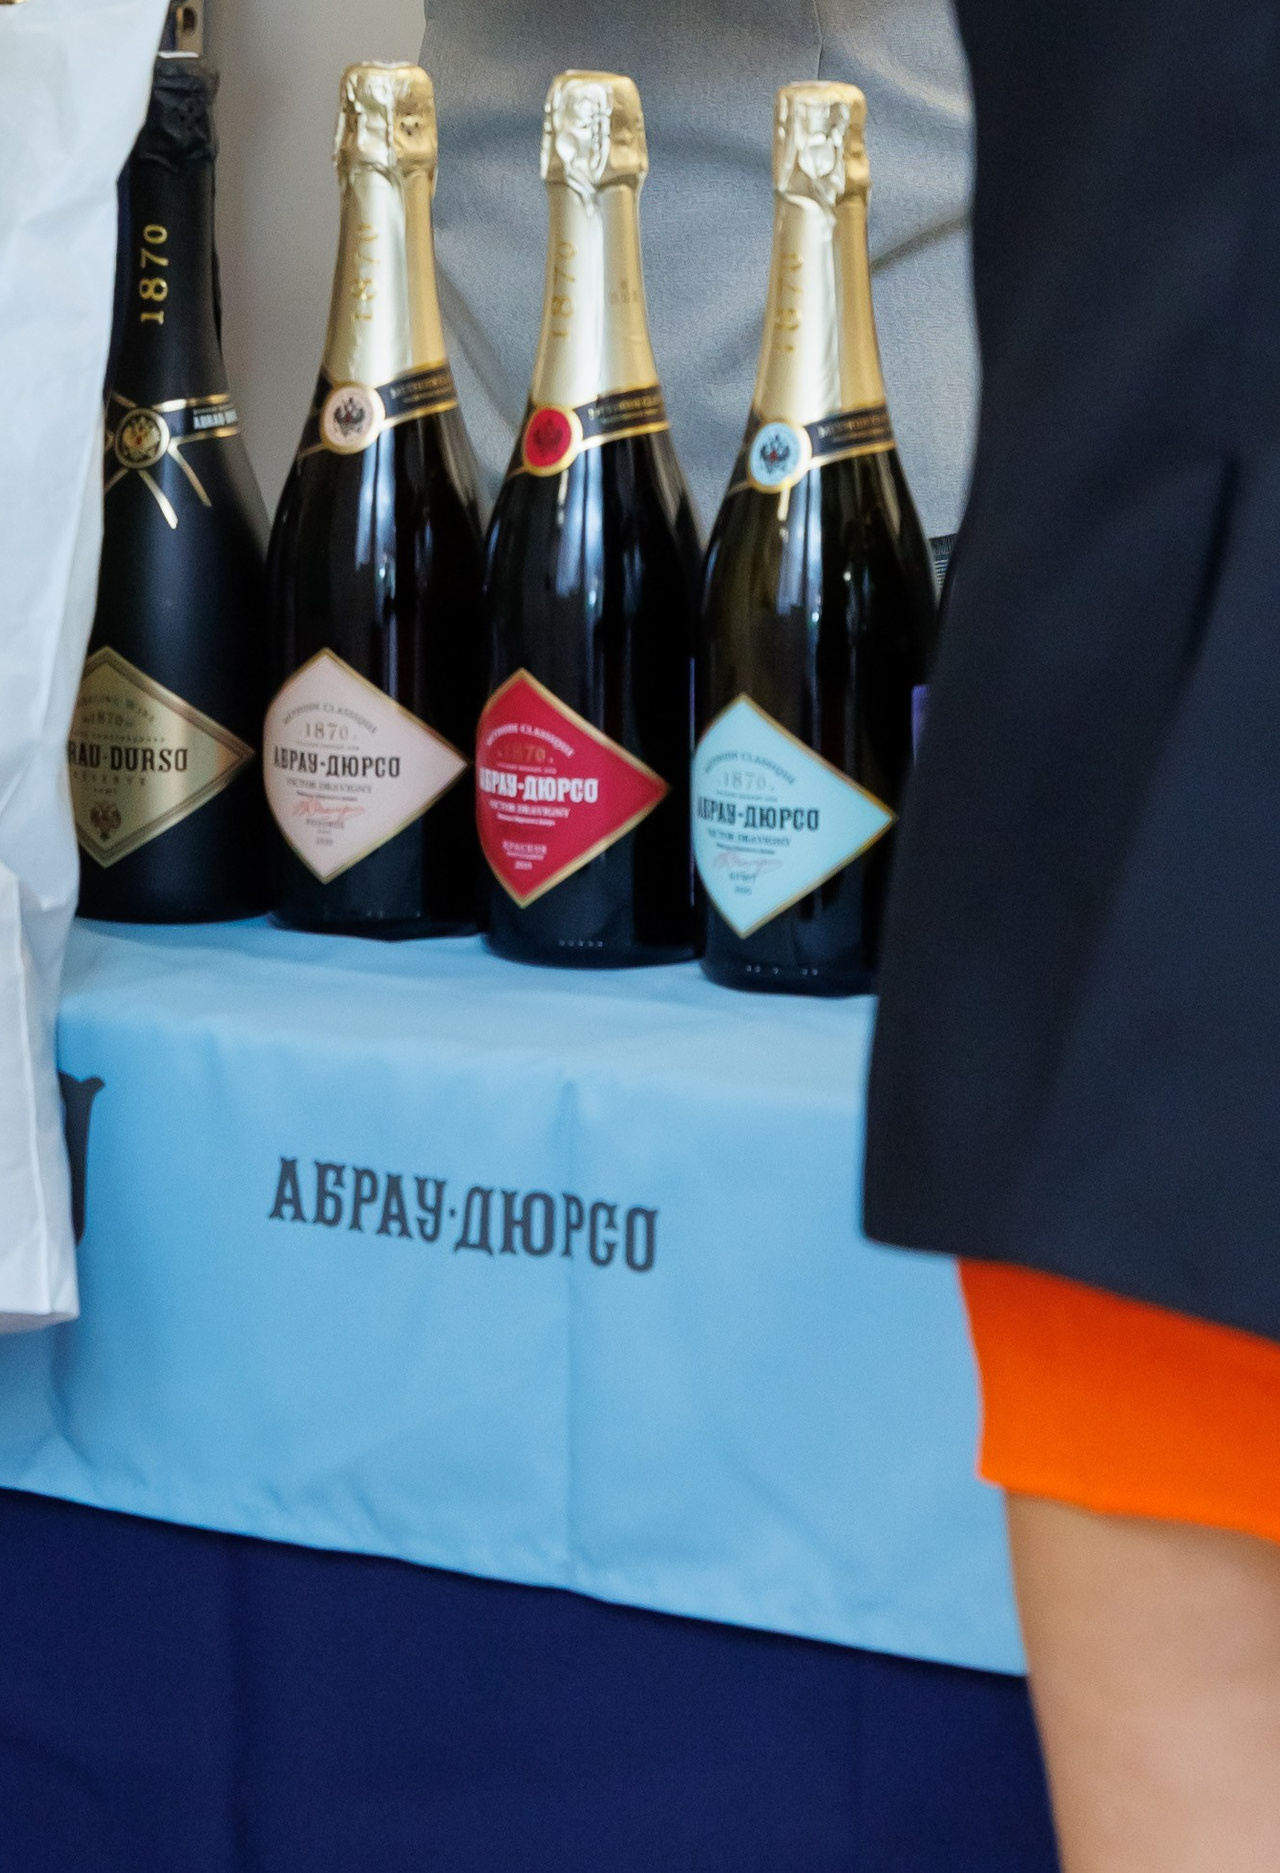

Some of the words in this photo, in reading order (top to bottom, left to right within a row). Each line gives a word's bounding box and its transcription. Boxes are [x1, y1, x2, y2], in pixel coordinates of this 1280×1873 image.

[139, 224, 169, 325] 1870
[349, 223, 380, 324] 1870
[549, 240, 577, 339] 1870
[773, 252, 804, 353] 1870
[273, 746, 401, 778] АБРАУ-ДЮРСО
[304, 721, 349, 740] 1870
